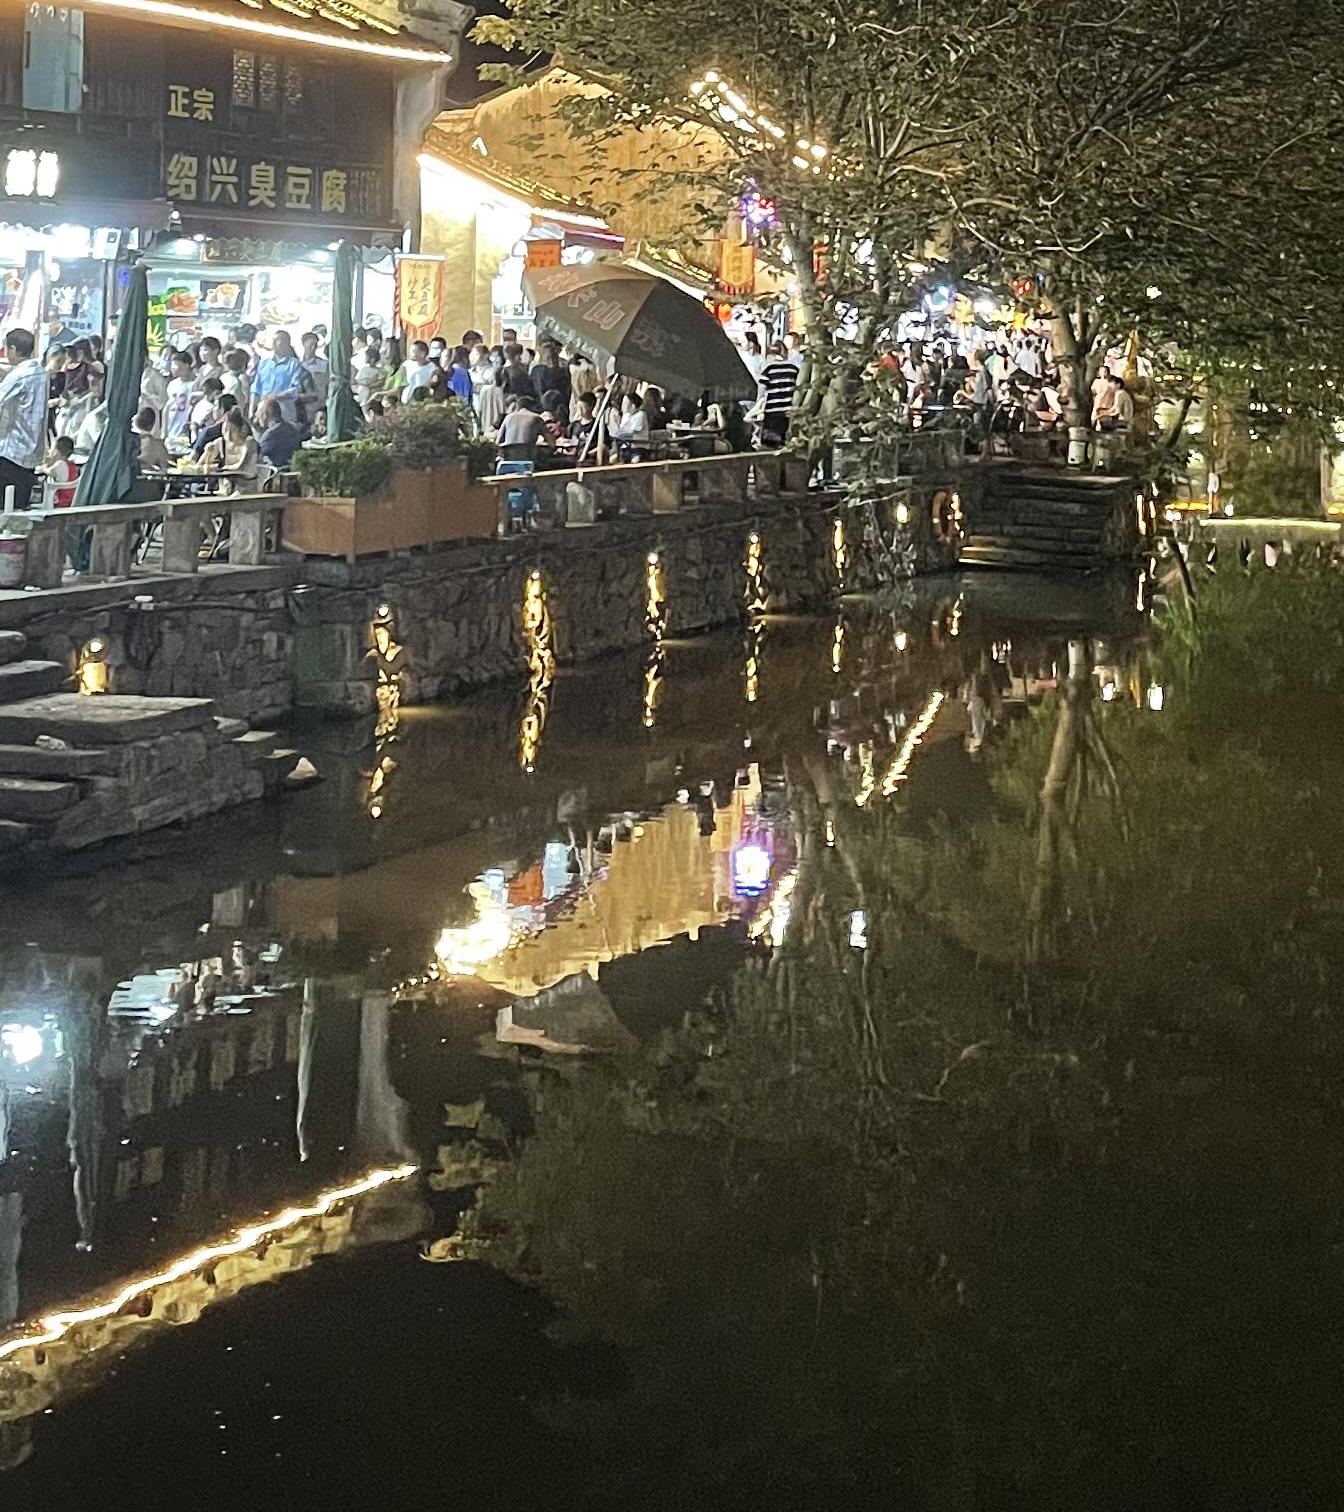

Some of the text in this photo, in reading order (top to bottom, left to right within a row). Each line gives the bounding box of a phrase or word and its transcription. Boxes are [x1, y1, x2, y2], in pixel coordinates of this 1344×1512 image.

[167, 85, 214, 121] 正宗
[166, 152, 348, 214] 绍兴臭豆腐
